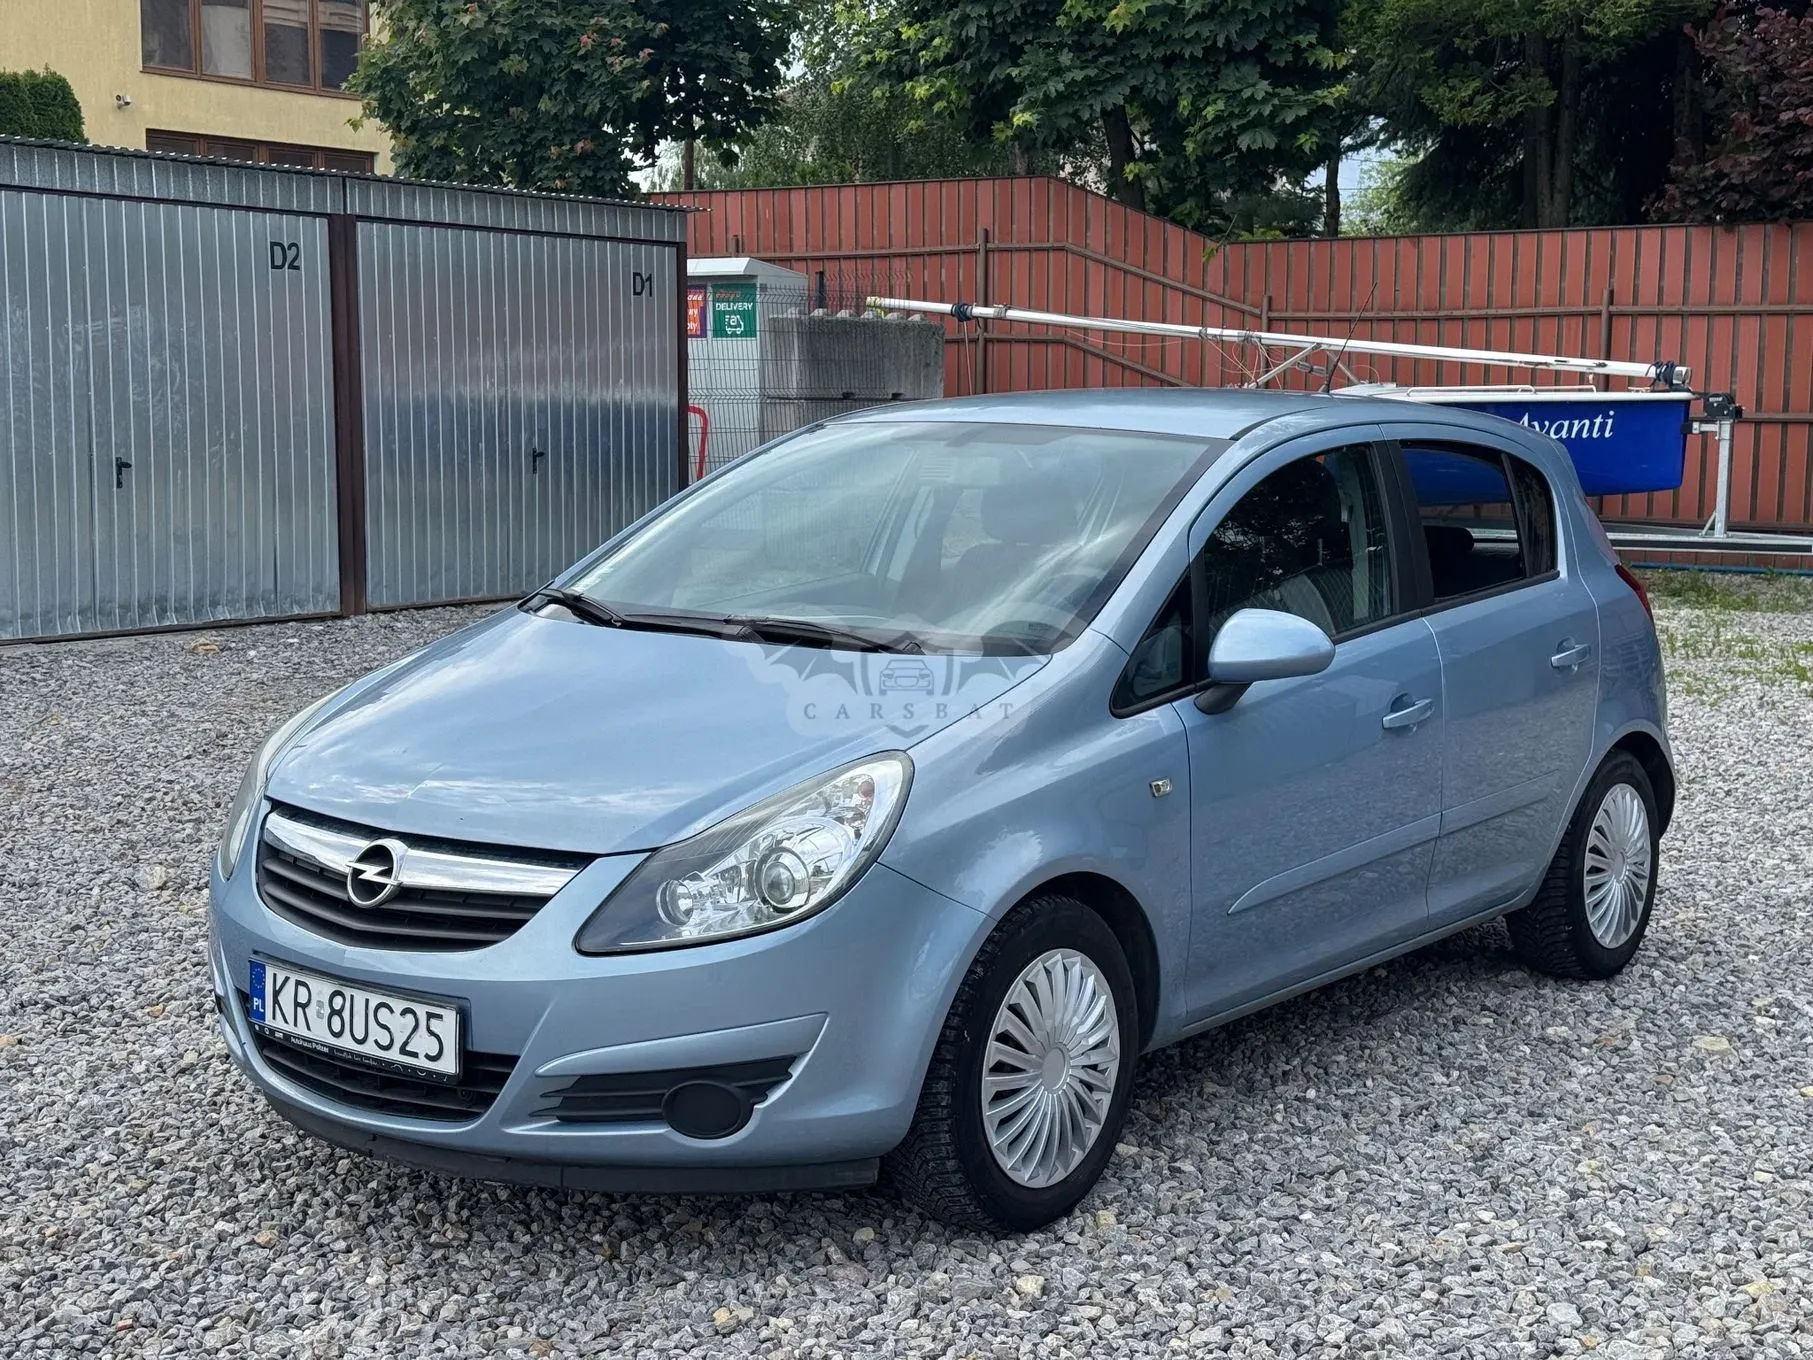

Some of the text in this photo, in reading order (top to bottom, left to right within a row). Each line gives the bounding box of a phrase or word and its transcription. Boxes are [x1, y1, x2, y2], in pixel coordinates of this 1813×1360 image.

[270, 241, 300, 270] D2
[632, 272, 653, 297] D1
[715, 302, 753, 311] DELIVERY
[253, 997, 265, 1013] PL
[271, 972, 444, 1063] KR 8US25
